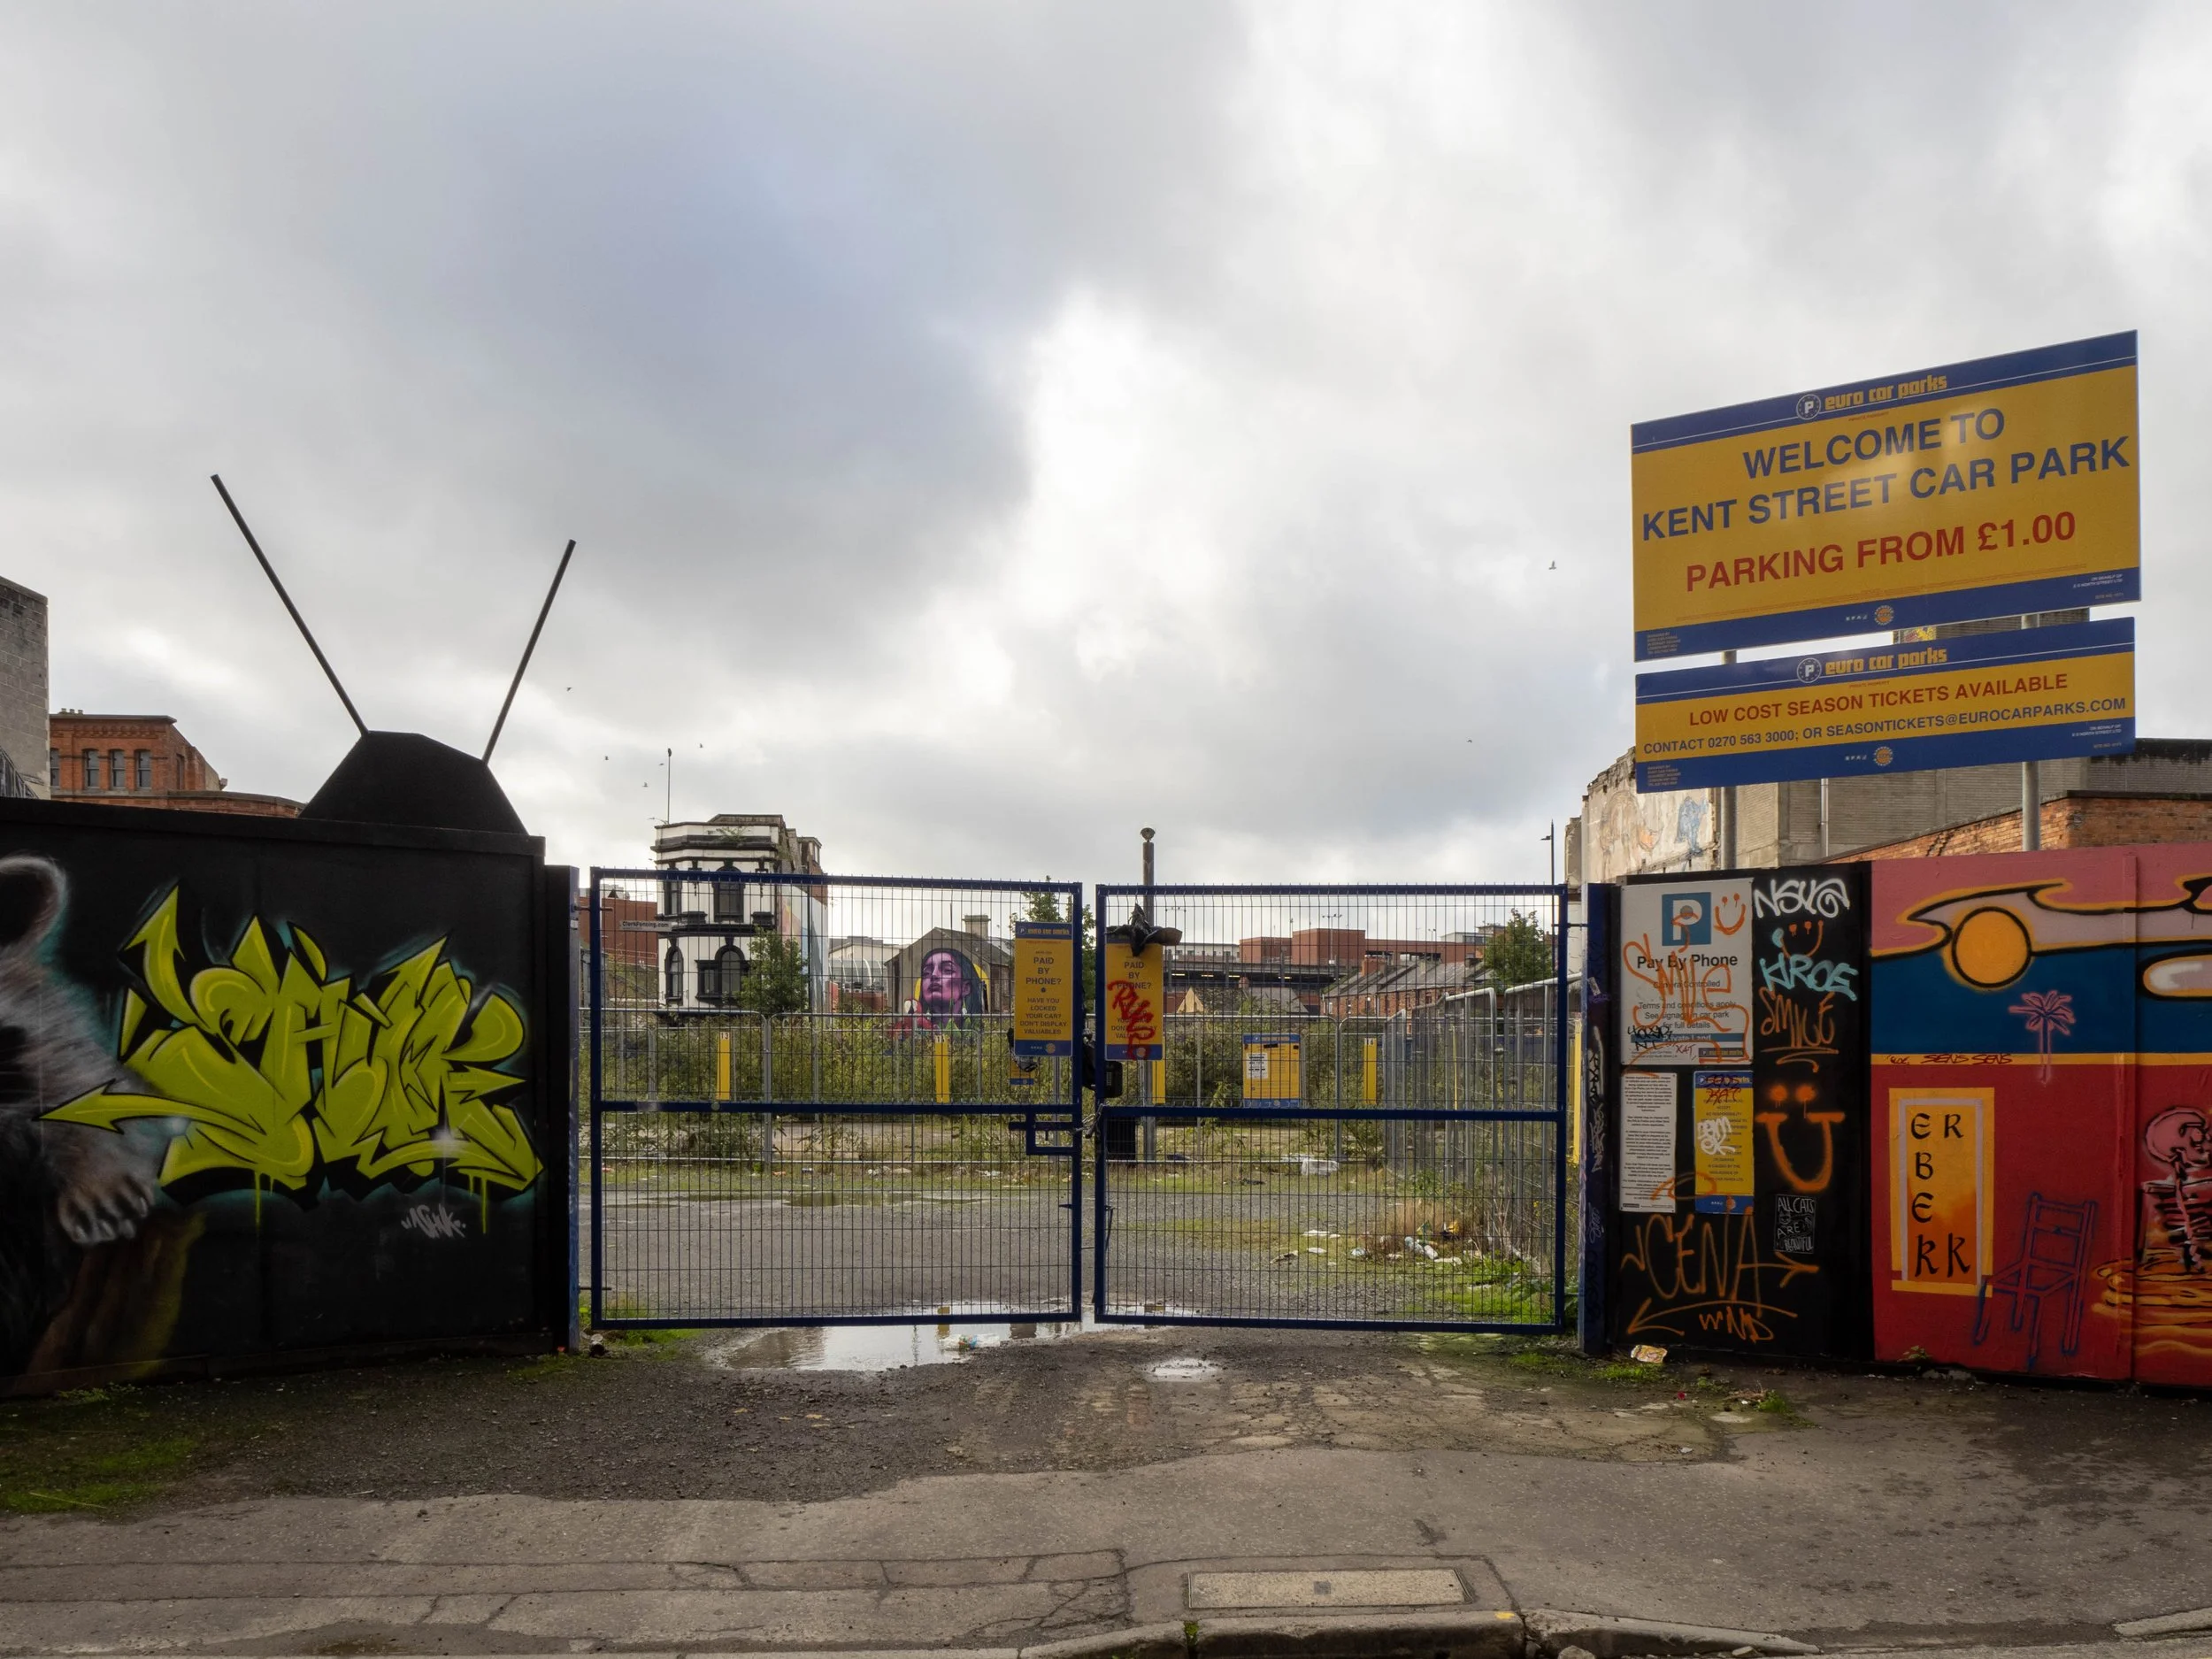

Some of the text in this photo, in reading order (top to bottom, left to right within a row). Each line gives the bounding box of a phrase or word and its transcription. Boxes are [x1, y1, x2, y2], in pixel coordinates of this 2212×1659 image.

[1824, 391, 1864, 410] euro
[1869, 385, 1894, 402] car
[1898, 374, 1947, 398] parks
[1742, 408, 2005, 479] WELCOME TO
[1643, 436, 2130, 541] KENT STREET CAR PARK
[1686, 511, 2076, 592] PARKING FROM £1.00
[1825, 657, 1864, 675] euro
[1869, 655, 1894, 670] car
[1898, 647, 1947, 669] parks
[1690, 673, 2067, 726] LOW COST SEASON TICKETS AVAILABLE
[1644, 738, 1703, 754] CONTACT
[1708, 736, 1737, 749] 0270
[1740, 733, 1762, 745] 563
[1802, 727, 1822, 739] OR
[1826, 698, 2125, 737] SEASONTICKETS@EUROCARPARKS.COM
[1672, 899, 1702, 941] P
[1637, 954, 1738, 972] Pay By Phone
[1793, 1197, 1815, 1214] CATS
[1777, 1222, 1801, 1239] ARE
